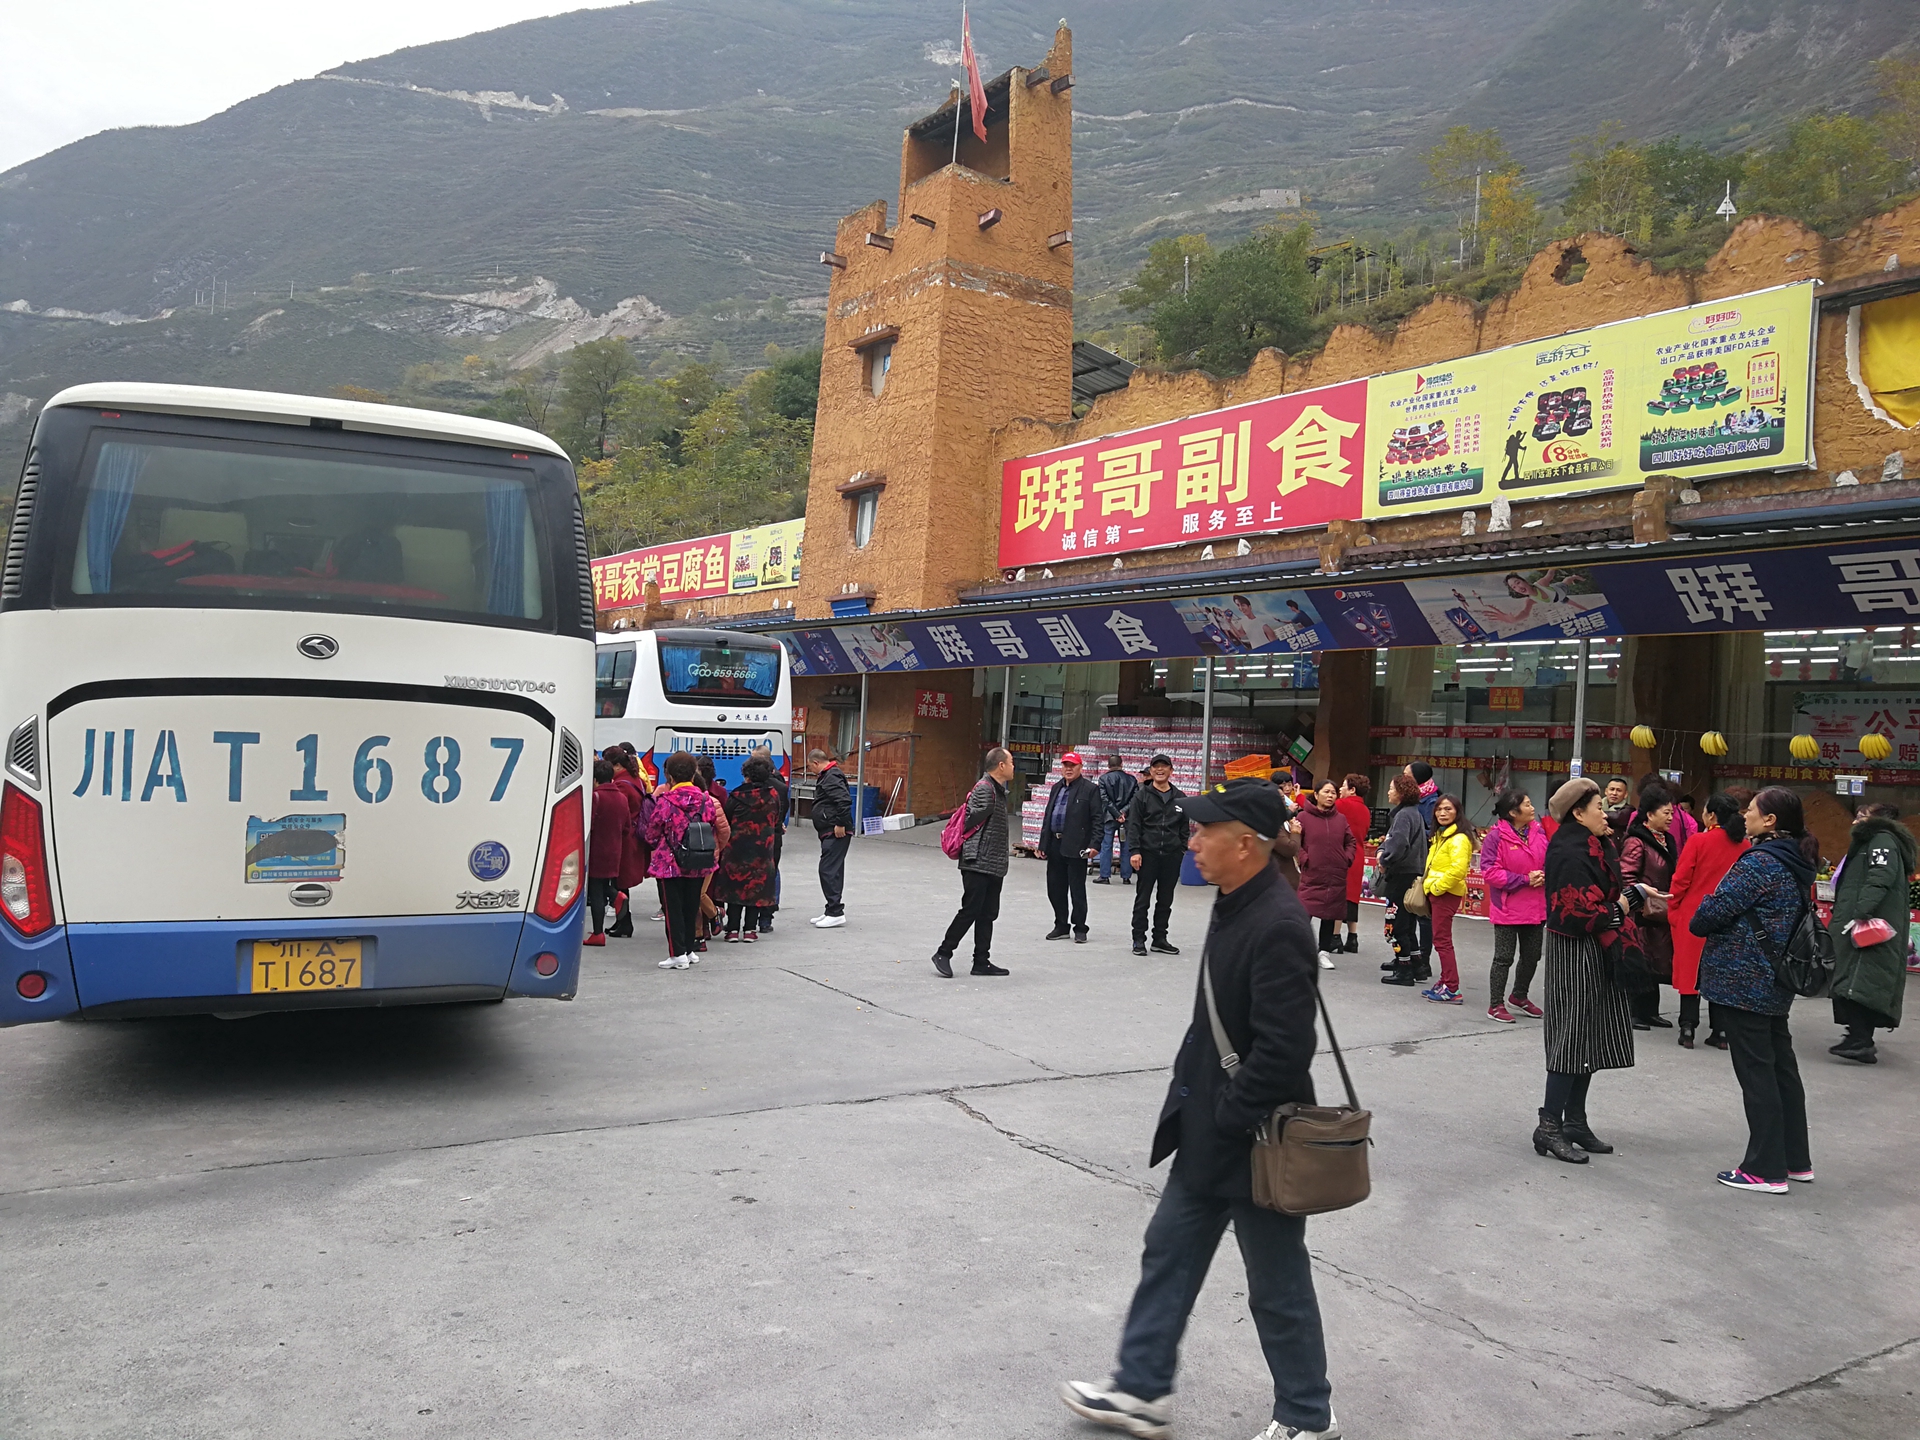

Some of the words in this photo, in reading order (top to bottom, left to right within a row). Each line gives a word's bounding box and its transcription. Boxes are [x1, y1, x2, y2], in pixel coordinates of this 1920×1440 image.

[1656, 325, 1776, 355] 农业产业化国家重点龙头企业
[1660, 337, 1770, 365] 出口产品获得美国FDA注册
[1389, 384, 1478, 408] 农业产业化国家重点龙头企业
[1553, 446, 1568, 462] 8
[1652, 437, 1770, 464] 四川好好吃食品有限公司
[1061, 523, 1145, 551] 诚信第一
[1182, 501, 1284, 534] 服务至上
[922, 692, 946, 705] 水果
[917, 704, 949, 719] 清洗池
[456, 889, 521, 909] 大金龙
[258, 959, 358, 987] T1687
